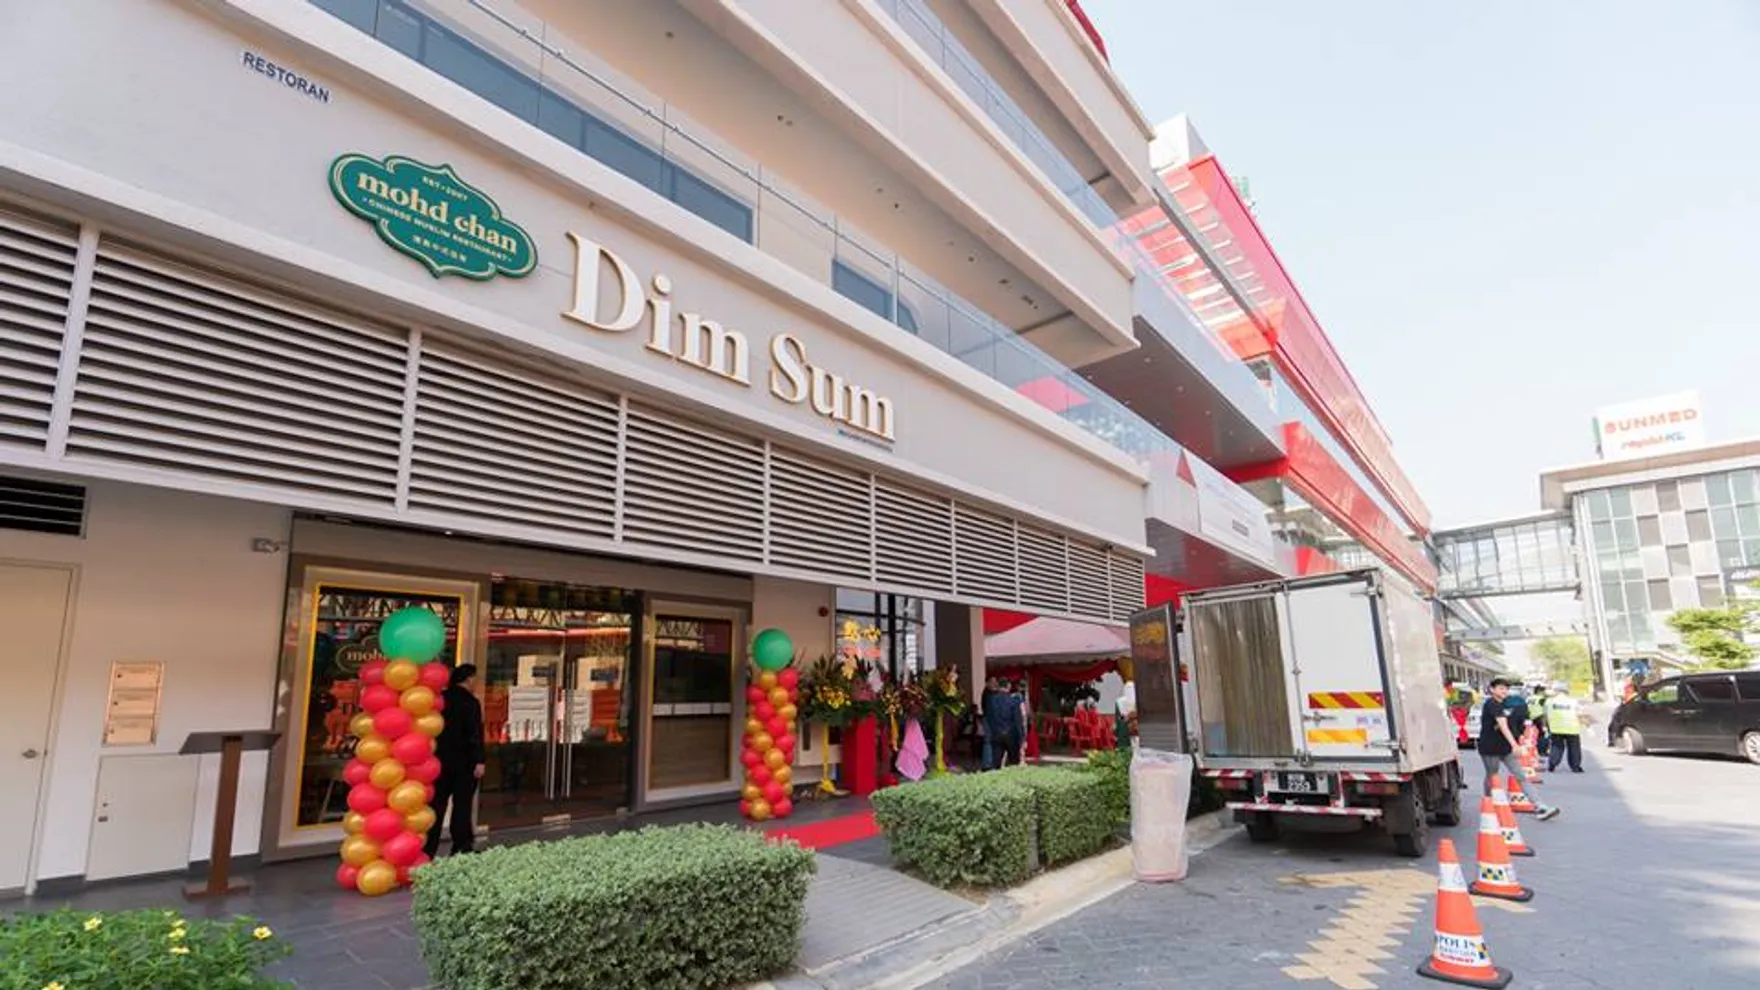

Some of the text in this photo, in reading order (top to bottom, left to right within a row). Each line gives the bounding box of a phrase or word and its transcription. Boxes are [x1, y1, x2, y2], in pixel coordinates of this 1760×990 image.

[243, 51, 330, 103] RESTORAN
[357, 171, 449, 224] mohd
[453, 214, 518, 255] chan
[560, 230, 896, 443] Dim Sum
[1604, 408, 1698, 435] SUNMED
